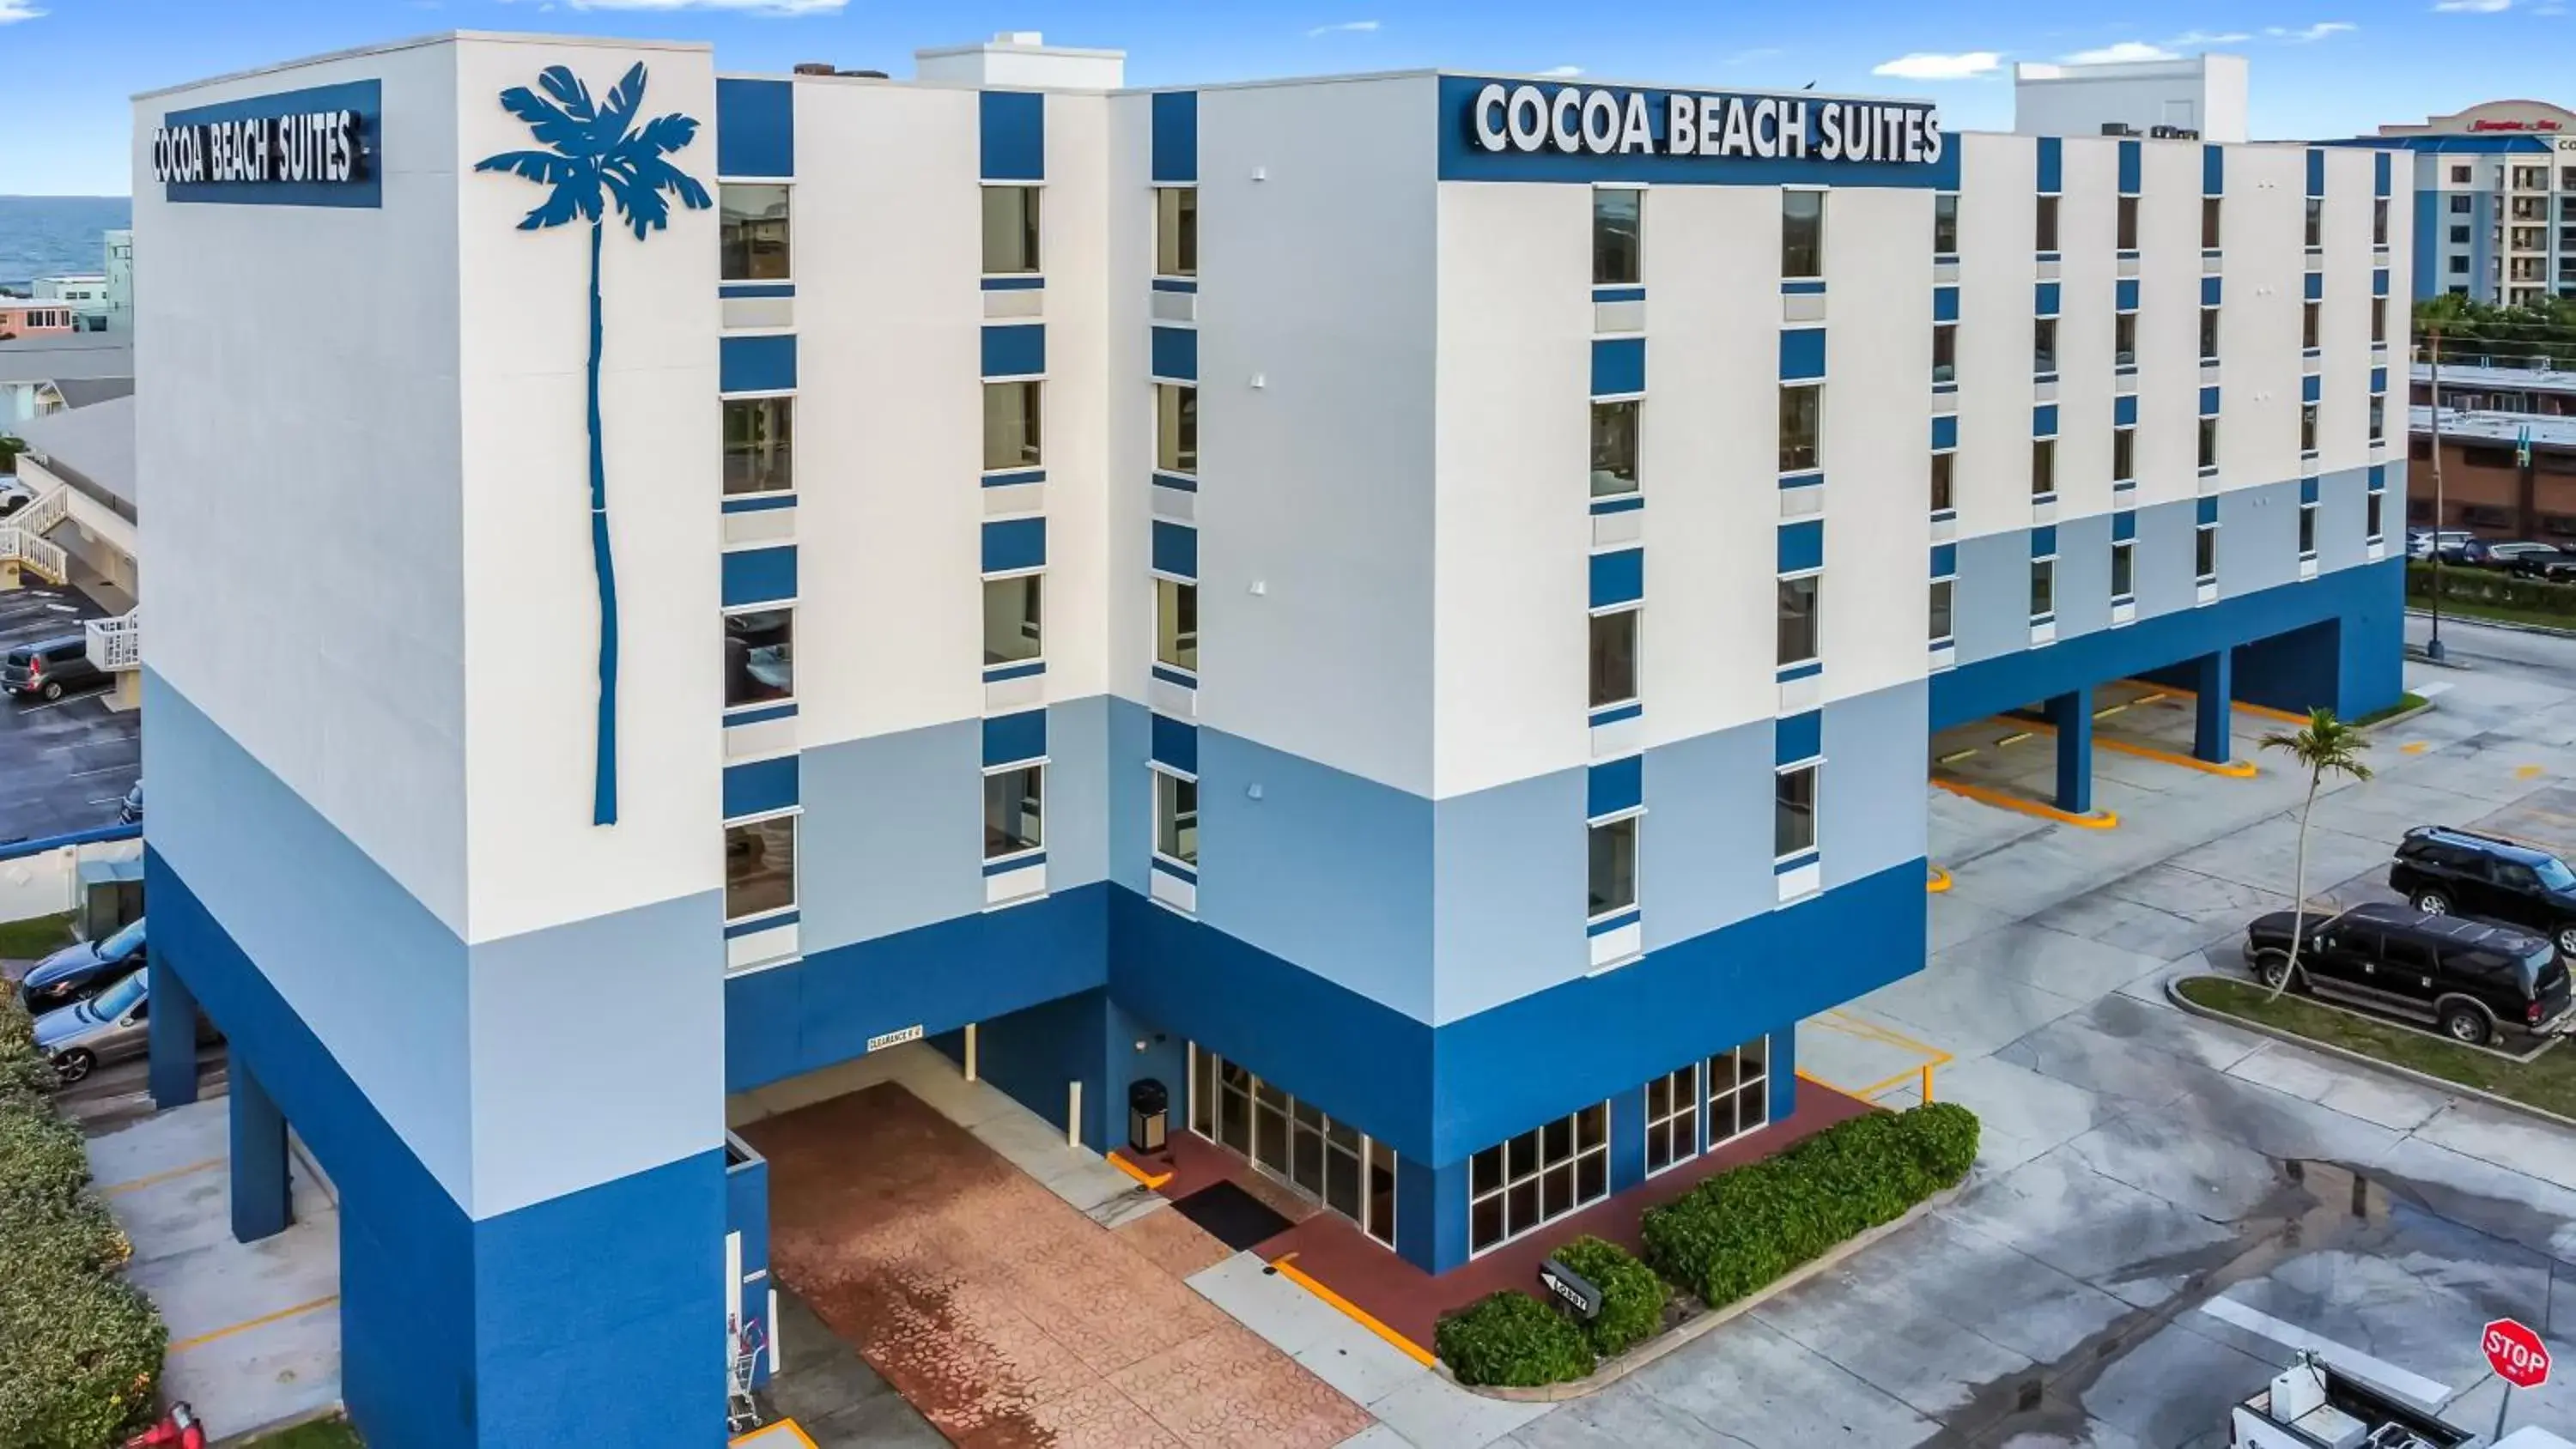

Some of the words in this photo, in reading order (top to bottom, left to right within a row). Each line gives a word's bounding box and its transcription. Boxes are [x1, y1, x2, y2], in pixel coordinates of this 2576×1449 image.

[152, 124, 204, 183] COCOA
[211, 118, 269, 182] BEACH
[279, 109, 351, 182] SUITES
[1476, 83, 1654, 154] COCOA
[1668, 94, 1806, 158] BEACH
[1819, 101, 1941, 164] SUITES
[1554, 1280, 1587, 1308] LOBBY
[2487, 1331, 2545, 1373] STOP
